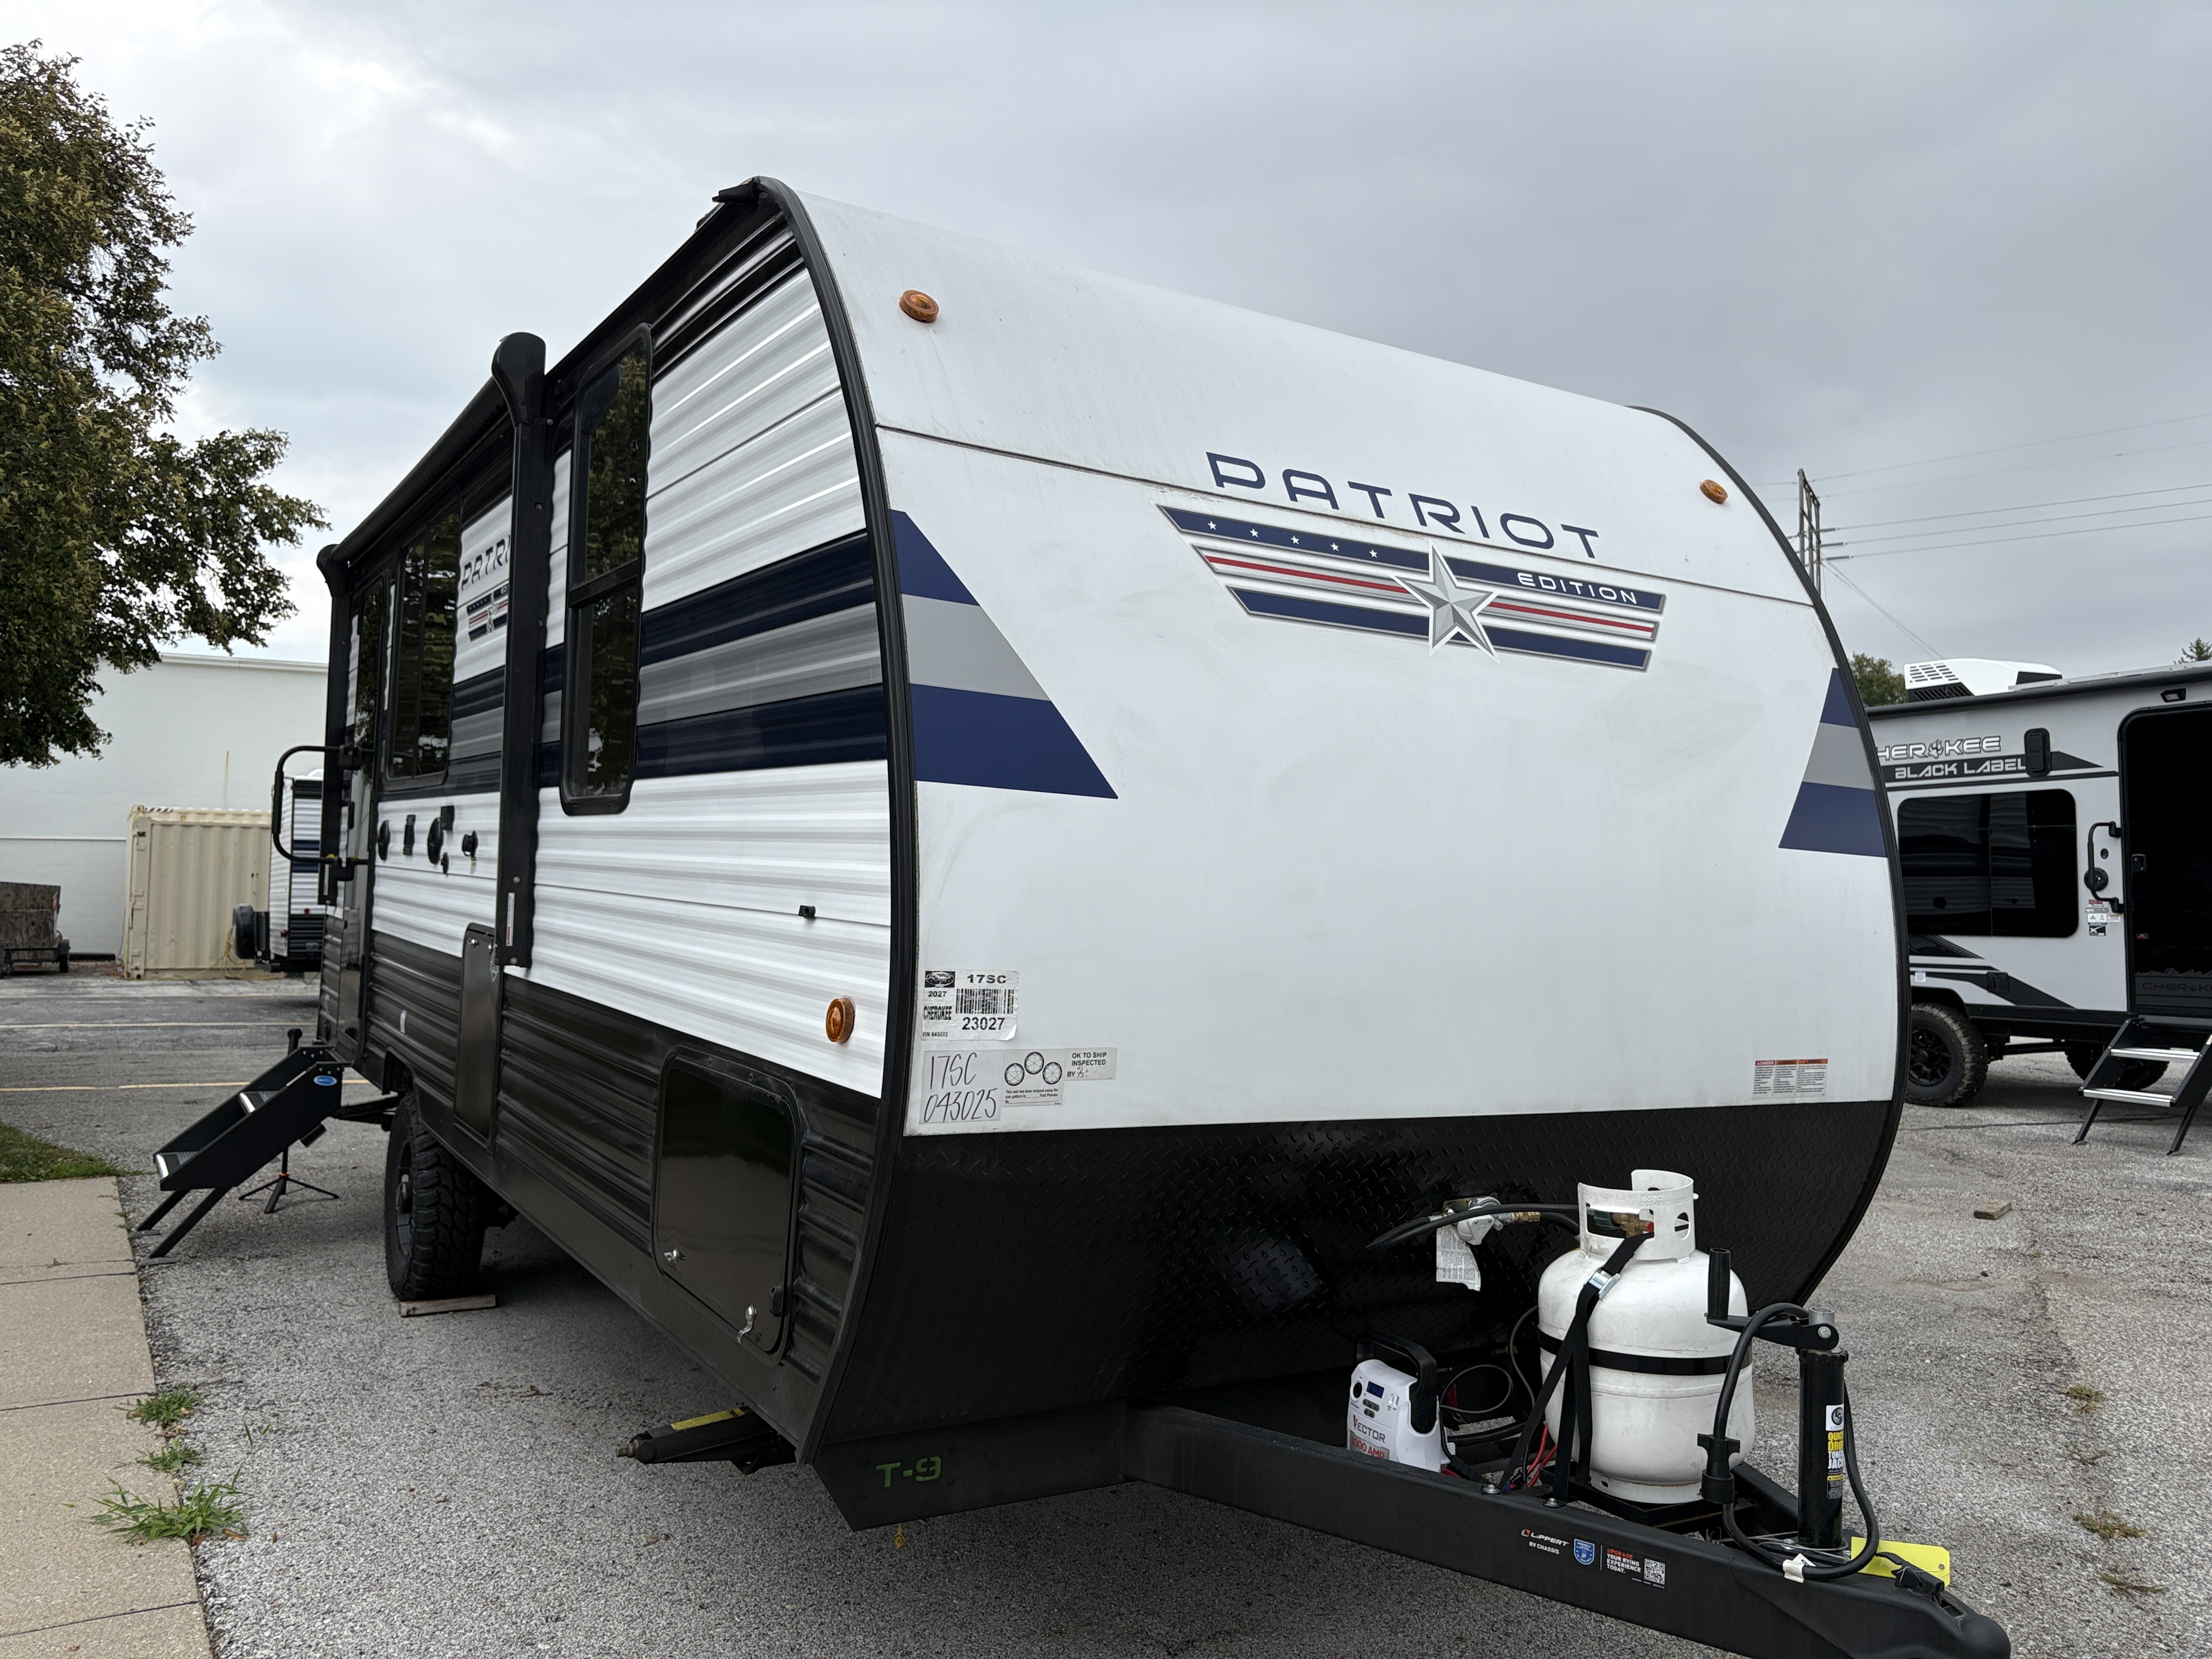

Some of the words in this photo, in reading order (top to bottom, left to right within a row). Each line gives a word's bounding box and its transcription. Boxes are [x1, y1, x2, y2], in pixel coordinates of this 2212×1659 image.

[1205, 452, 1600, 558] PATRIOT
[461, 534, 511, 591] PATRI
[1517, 572, 1638, 605] EDITION
[1895, 763, 1957, 780] BLACK
[1963, 758, 2026, 775] LABEL
[967, 974, 1007, 984] 17SC
[923, 1006, 952, 1020] CHEROKEE
[962, 1017, 1006, 1030] 23027
[923, 1087, 998, 1123] 043025
[1353, 1414, 1386, 1444] VECTOR
[1828, 1431, 1843, 1442] QUIC
[876, 1456, 941, 1488] T-9
[1537, 1543, 1560, 1555] CHASSIS
[1607, 1548, 1633, 1560] UPGRADE
[1607, 1553, 1622, 1561] YOUR
[1606, 1558, 1641, 1573] EXPERIENCE
